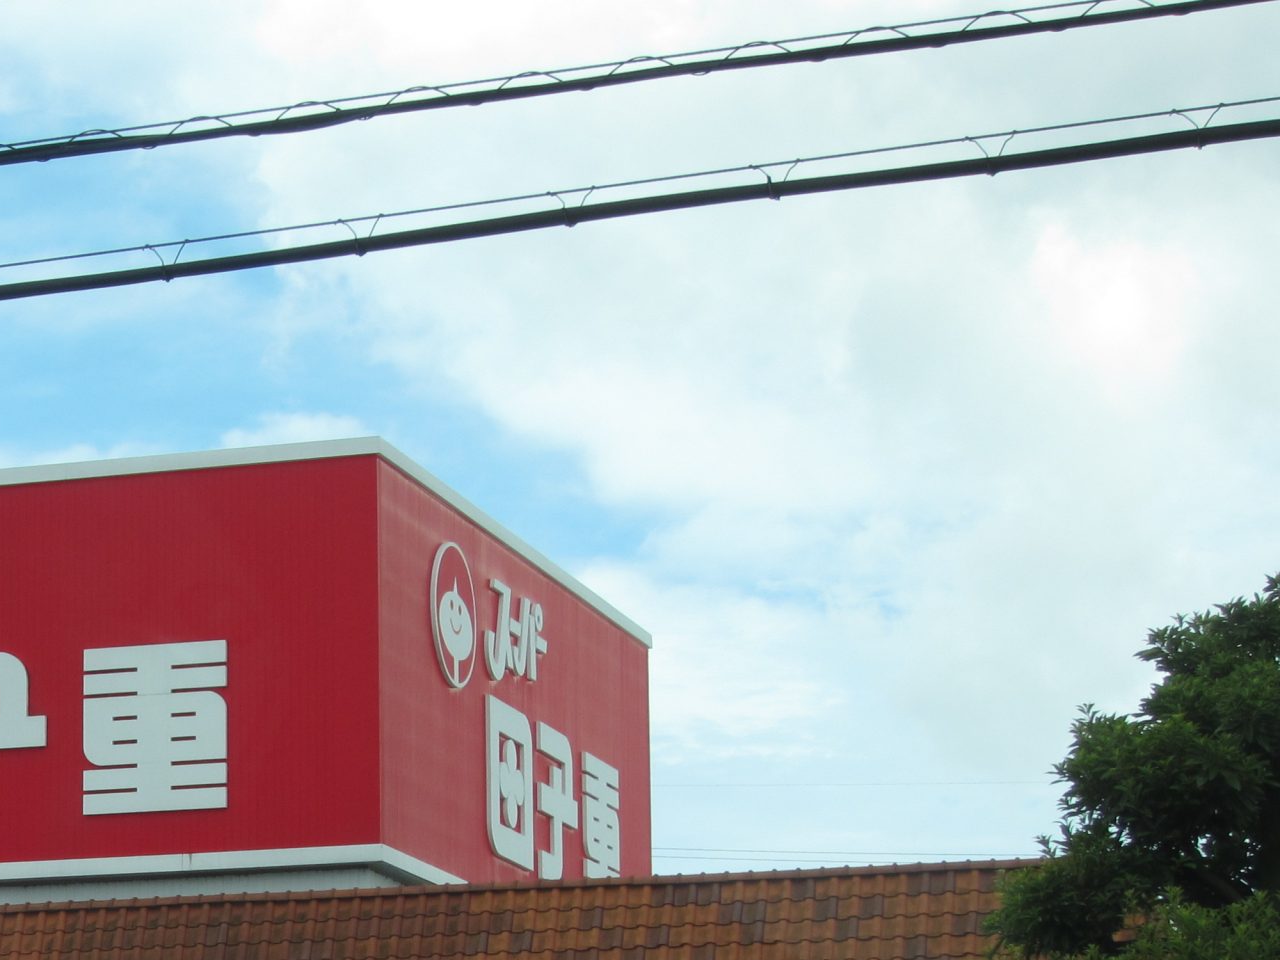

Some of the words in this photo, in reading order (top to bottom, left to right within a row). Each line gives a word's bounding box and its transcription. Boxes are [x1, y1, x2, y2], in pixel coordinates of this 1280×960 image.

[483, 577, 548, 681] スーパー
[484, 693, 621, 880] 田子重
